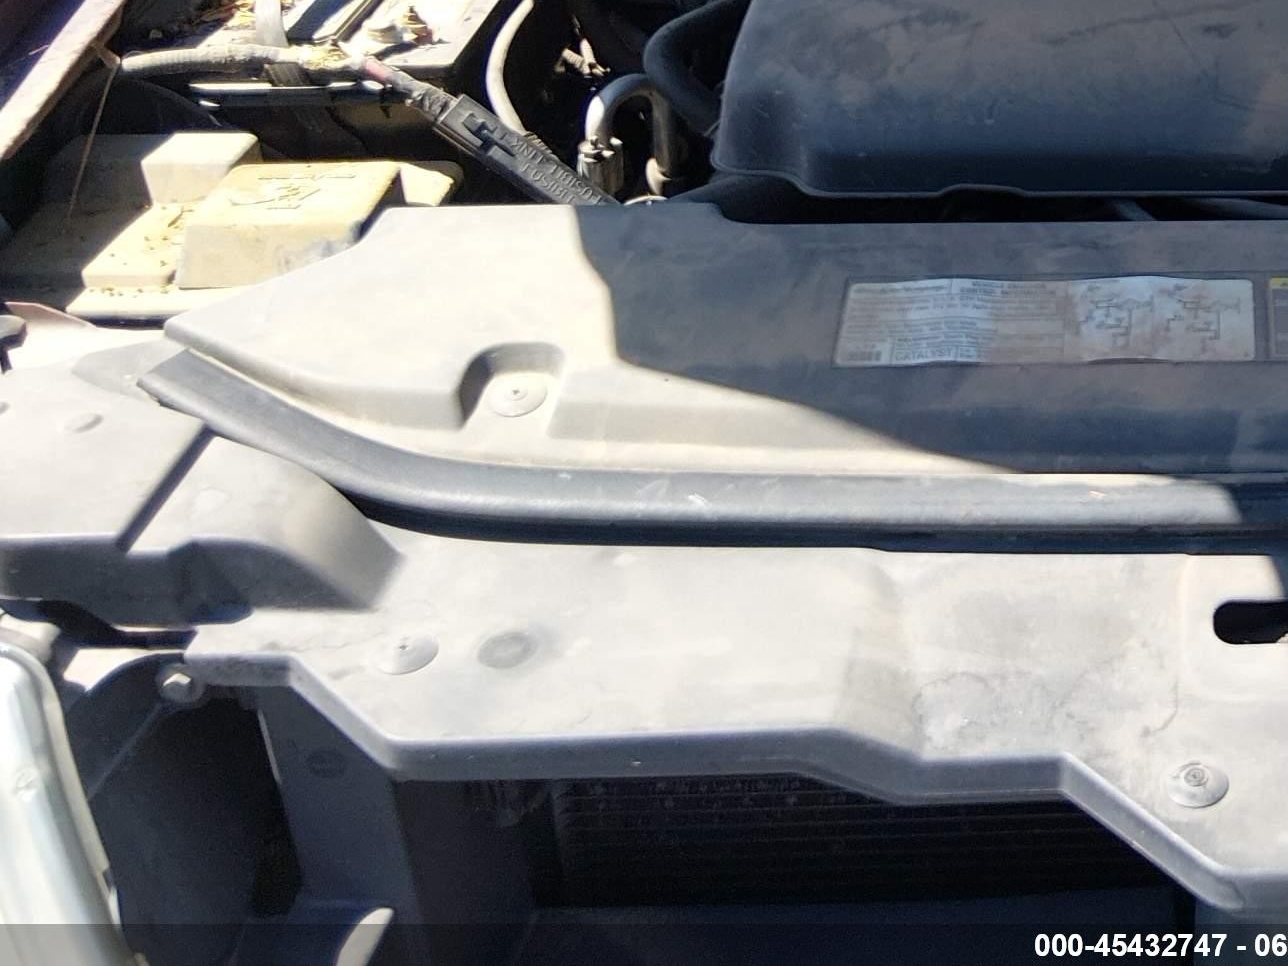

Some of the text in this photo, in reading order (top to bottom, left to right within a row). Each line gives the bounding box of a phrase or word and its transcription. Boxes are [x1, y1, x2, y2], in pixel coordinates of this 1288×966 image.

[510, 136, 604, 206] FUSIBLE LINK
[895, 347, 953, 362] CATALYST
